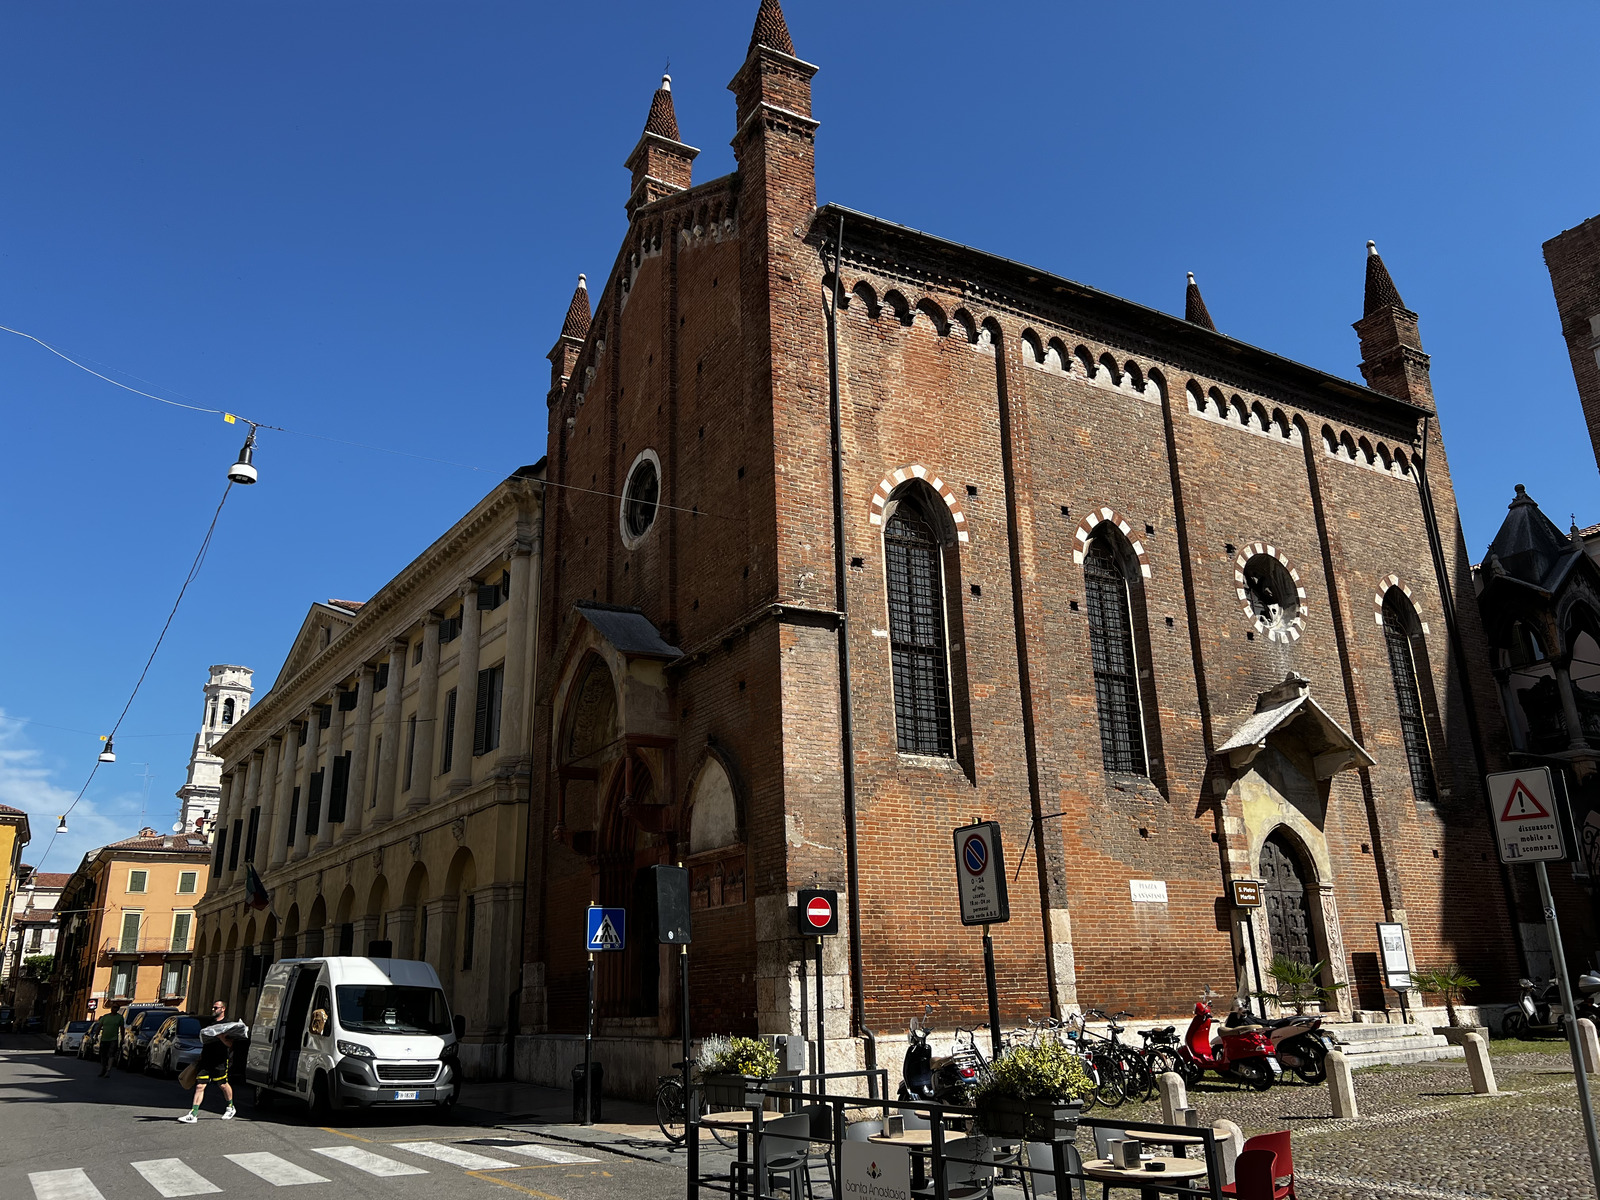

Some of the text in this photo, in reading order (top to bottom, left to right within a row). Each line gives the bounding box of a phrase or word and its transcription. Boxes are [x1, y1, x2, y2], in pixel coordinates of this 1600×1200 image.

[1518, 824, 1555, 832] dissuasore
[1520, 834, 1544, 842] mobile
[1522, 844, 1559, 852] scomparsa
[845, 1179, 906, 1200] Santa Anastasia
